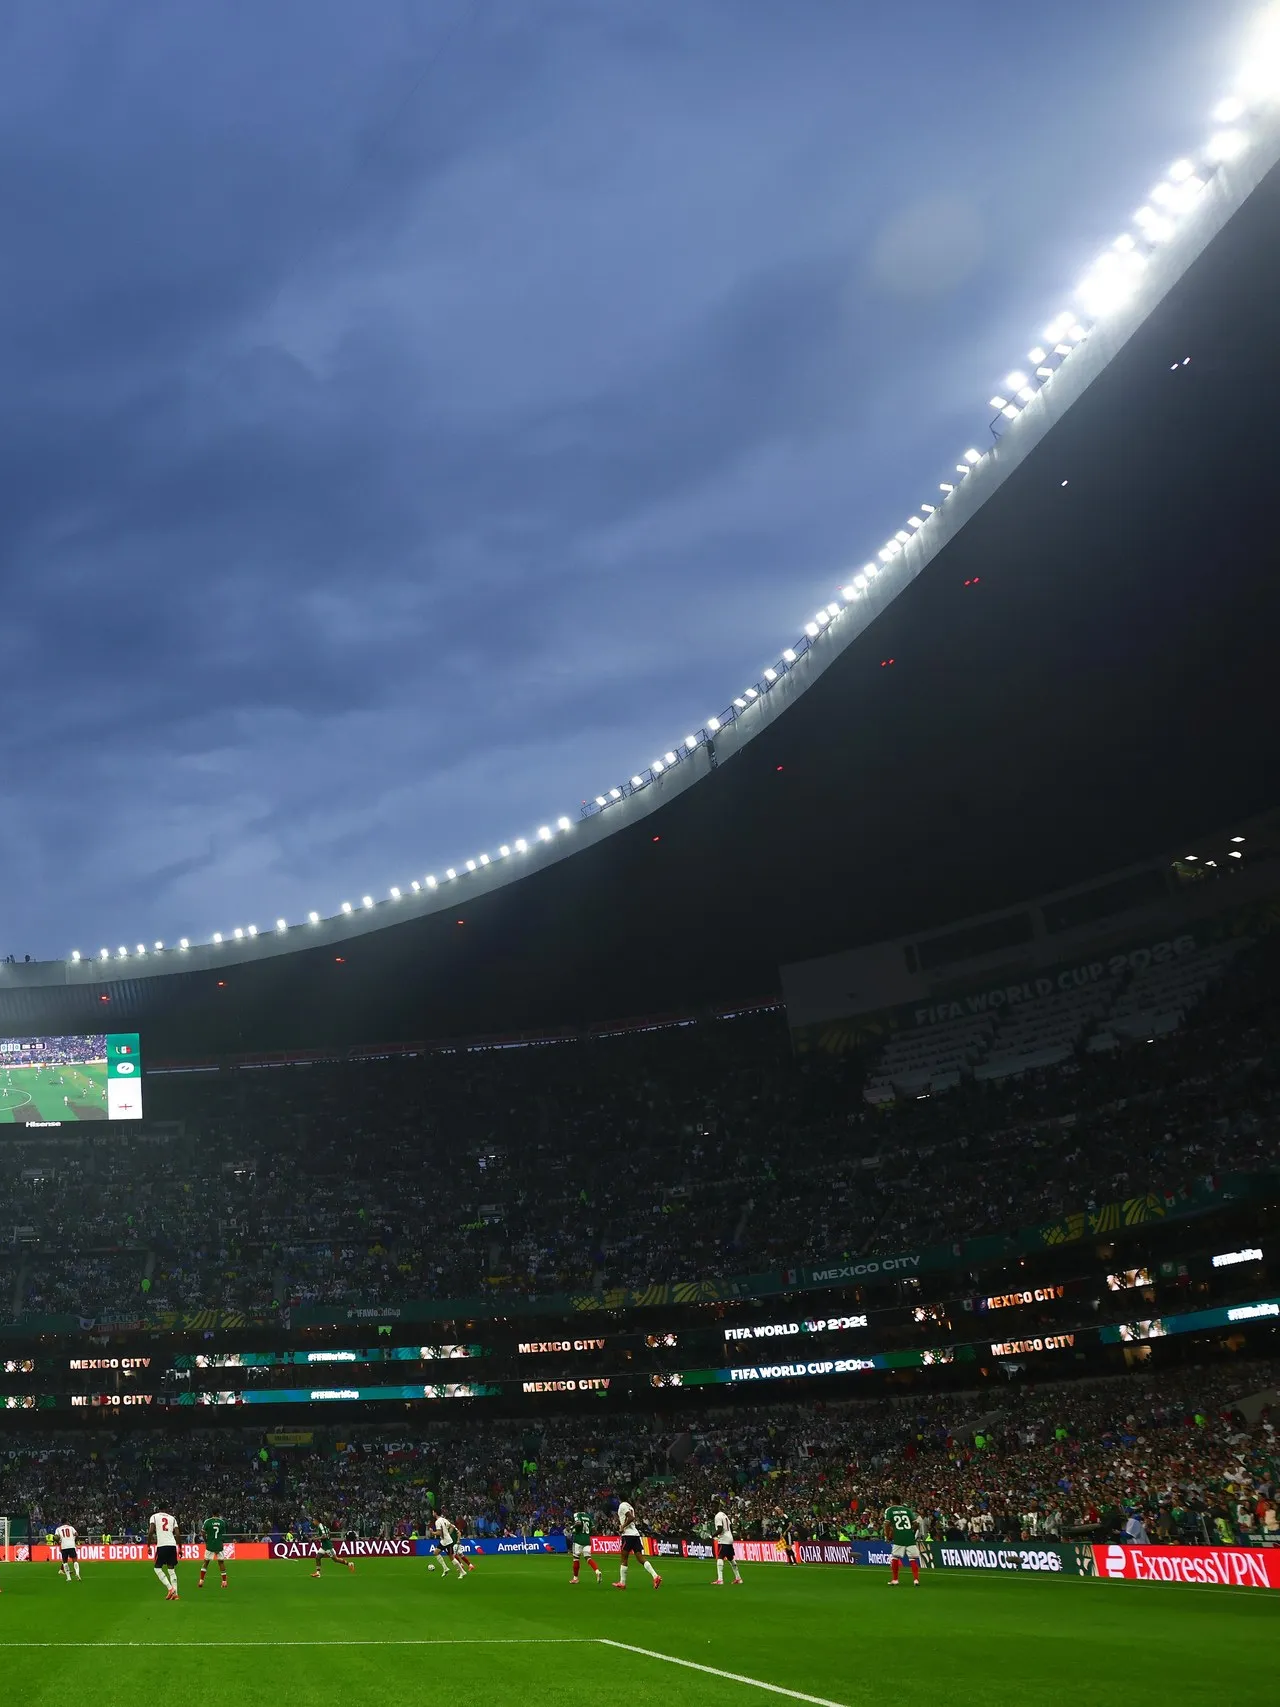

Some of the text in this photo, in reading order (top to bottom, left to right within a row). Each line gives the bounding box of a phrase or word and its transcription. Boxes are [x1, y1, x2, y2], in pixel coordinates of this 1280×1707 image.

[1057, 962, 1104, 989] CUP
[813, 1256, 920, 1281] MEXICO CITY
[724, 1328, 752, 1340] FIFA
[753, 1323, 799, 1338] WORLD
[518, 1339, 605, 1353] MEXICO CITY
[991, 1335, 1075, 1356] MEXICO CITY
[70, 1358, 151, 1369] MEXICO CITY
[731, 1369, 759, 1381] FIFA
[760, 1364, 804, 1378] WORLD
[808, 1362, 834, 1374] CUP
[522, 1378, 610, 1393] MEXICO CITY
[123, 1395, 152, 1405] CITY
[162, 1518, 168, 1531] 2
[894, 1515, 911, 1530] 23
[61, 1528, 70, 1537] 10
[213, 1526, 219, 1539] 7
[109, 1545, 146, 1559] DEPOT
[339, 1540, 411, 1555] AIRWAYS
[498, 1543, 539, 1552] American
[800, 1546, 822, 1563] QATAR
[868, 1550, 893, 1564] America
[941, 1549, 962, 1566] FIFA
[961, 1550, 997, 1568] WORLD
[1020, 1551, 1060, 1571] 2026
[1130, 1550, 1270, 1588] ExpressVPN
